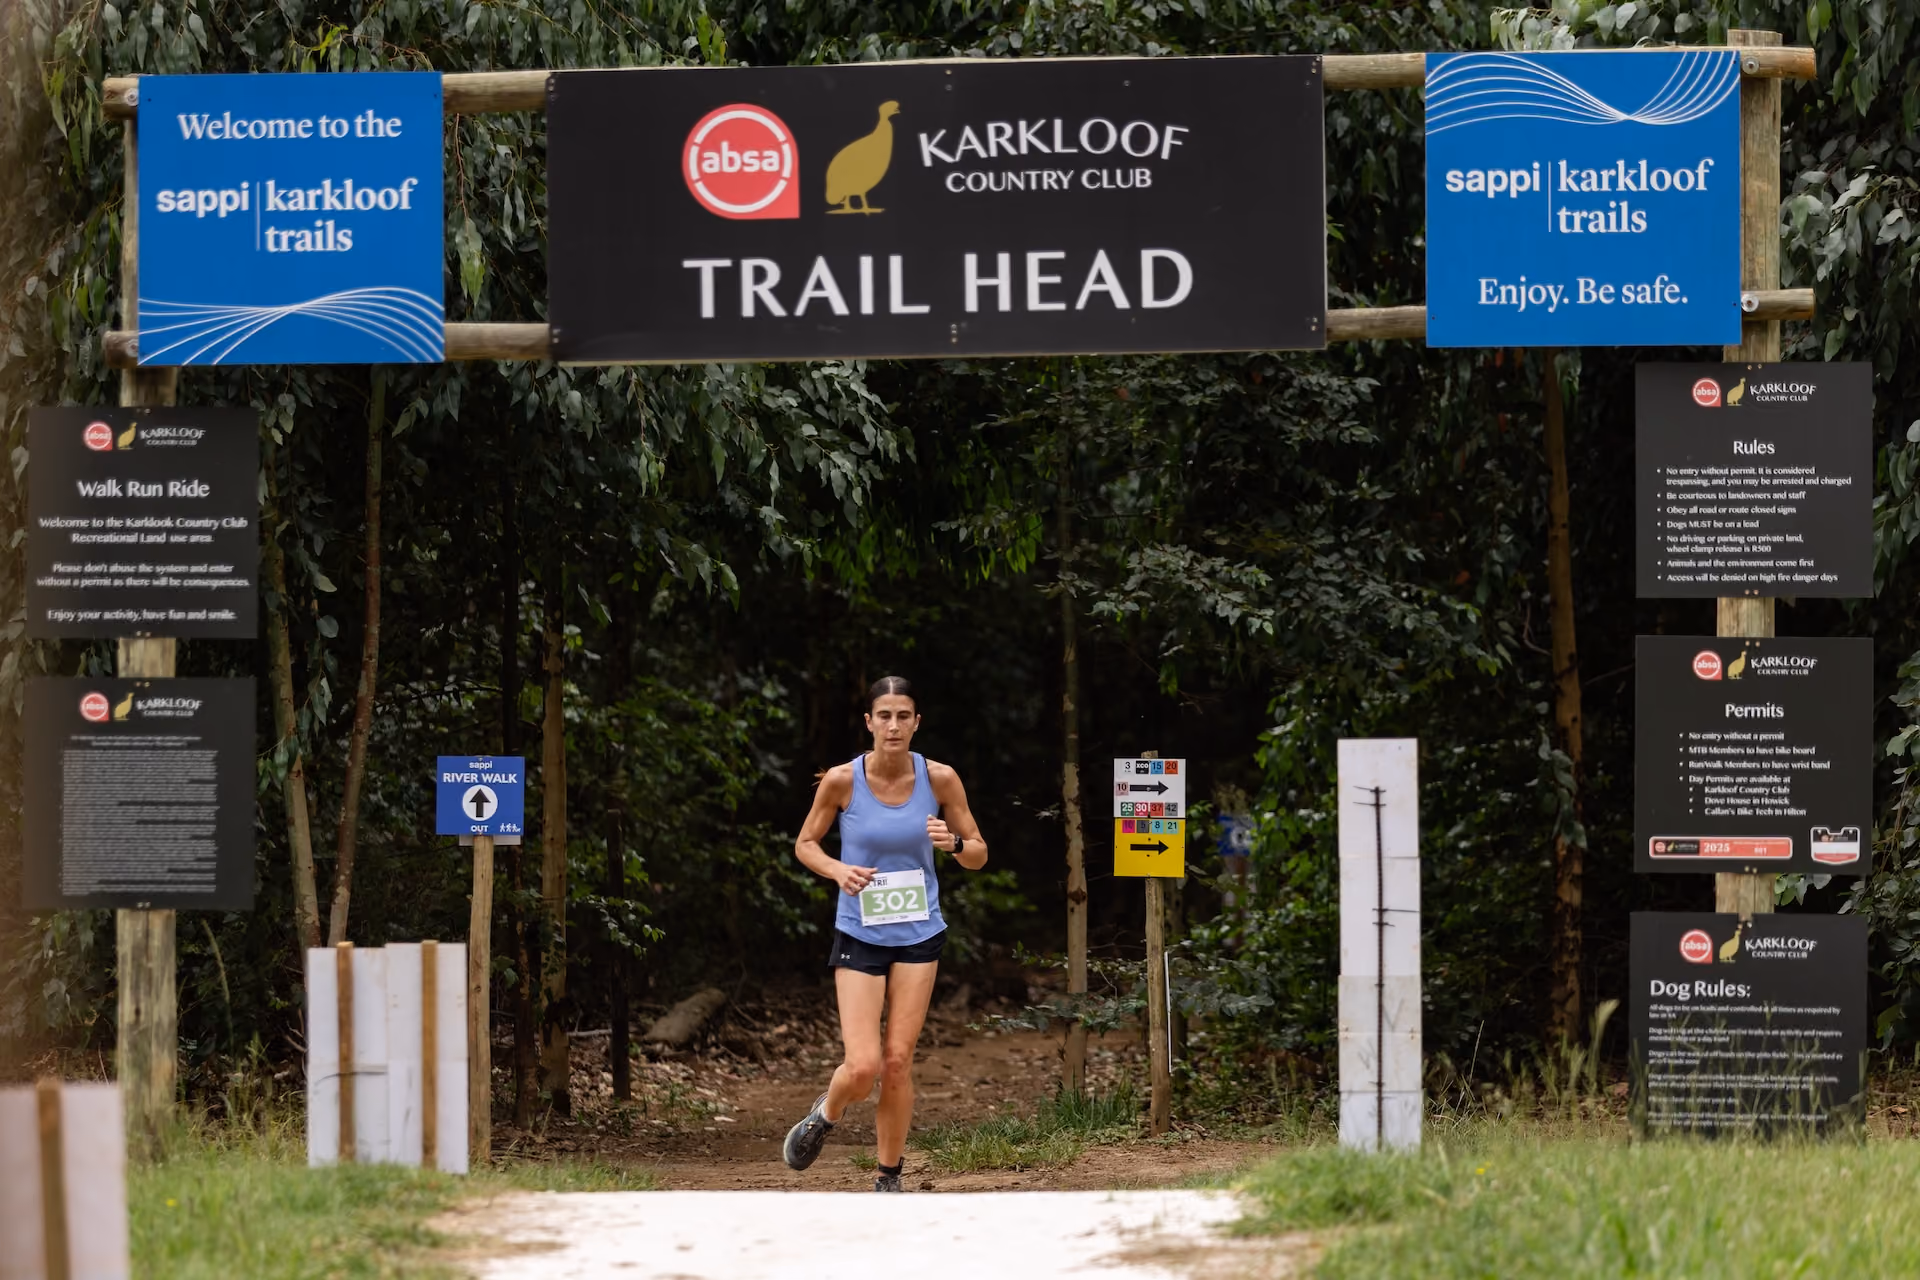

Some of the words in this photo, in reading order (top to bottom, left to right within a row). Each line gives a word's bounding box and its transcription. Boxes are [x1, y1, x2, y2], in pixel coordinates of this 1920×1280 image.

[177, 111, 314, 140] Welcome
[318, 115, 349, 138] to
[355, 109, 402, 138] the
[918, 118, 1190, 168] KARKLOOF
[701, 141, 781, 174] absa
[945, 170, 1074, 193] COUNTRY
[1081, 168, 1152, 189] CLUB
[1446, 162, 1540, 198] sappi
[1557, 158, 1714, 192] karkloof
[156, 181, 250, 218] sappi
[265, 177, 419, 212] karkloof
[1557, 201, 1648, 233] trails
[265, 220, 353, 253] trails
[682, 254, 931, 319] TRAIL
[964, 248, 1194, 313] HEAD
[1478, 276, 1570, 313] Enjoy.
[1576, 278, 1615, 304] Be
[1621, 274, 1688, 304] safe.
[1696, 387, 1716, 396] absa
[1750, 383, 1816, 396] KARKLOOF
[140, 428, 206, 439] KARKLOOF
[1733, 439, 1775, 455] Rules
[1700, 466, 1729, 475] without
[77, 479, 123, 497] Walk
[127, 481, 163, 497] Run
[168, 479, 210, 497] Ride
[1666, 506, 1688, 516] Obey
[1688, 505, 1698, 514] all
[1699, 505, 1717, 514] road
[1728, 506, 1749, 514] route
[1750, 505, 1776, 514] closed
[1777, 505, 1797, 516] signs
[38, 516, 90, 528] Welcome
[91, 518, 104, 528] to
[105, 516, 124, 528] the
[175, 518, 220, 530] Country
[221, 517, 248, 528] Club
[1666, 520, 1687, 530] Dogs
[1688, 520, 1712, 528] MUST
[1742, 520, 1760, 528] lead
[1679, 534, 1706, 544] driving
[1717, 534, 1745, 544] parking
[1758, 534, 1785, 544] private
[1666, 574, 1694, 582] Access
[1695, 573, 1708, 582] will
[1720, 573, 1747, 582] denied
[1759, 573, 1776, 583] high
[1777, 572, 1791, 581] fire
[1792, 573, 1819, 583] danger
[1820, 572, 1838, 583] days
[1750, 656, 1818, 669] KARKLOOF
[136, 698, 203, 710] KARKLOOF
[1725, 702, 1784, 718] Permits
[469, 760, 492, 770] sappi
[1166, 762, 1177, 770] 20
[443, 772, 478, 783] RIVER
[481, 773, 517, 784] WALK
[1117, 783, 1127, 792] 10
[1122, 804, 1133, 812] 25
[1135, 803, 1147, 812] 30
[1166, 804, 1177, 812] 42
[1155, 821, 1160, 829] 8
[1167, 821, 1177, 830] 21
[1703, 842, 1730, 853] 2025
[872, 890, 918, 912] 302
[1744, 937, 1817, 951] KARKLOOF
[1650, 980, 1691, 1001] Dog
[1694, 979, 1750, 998] Rules:
